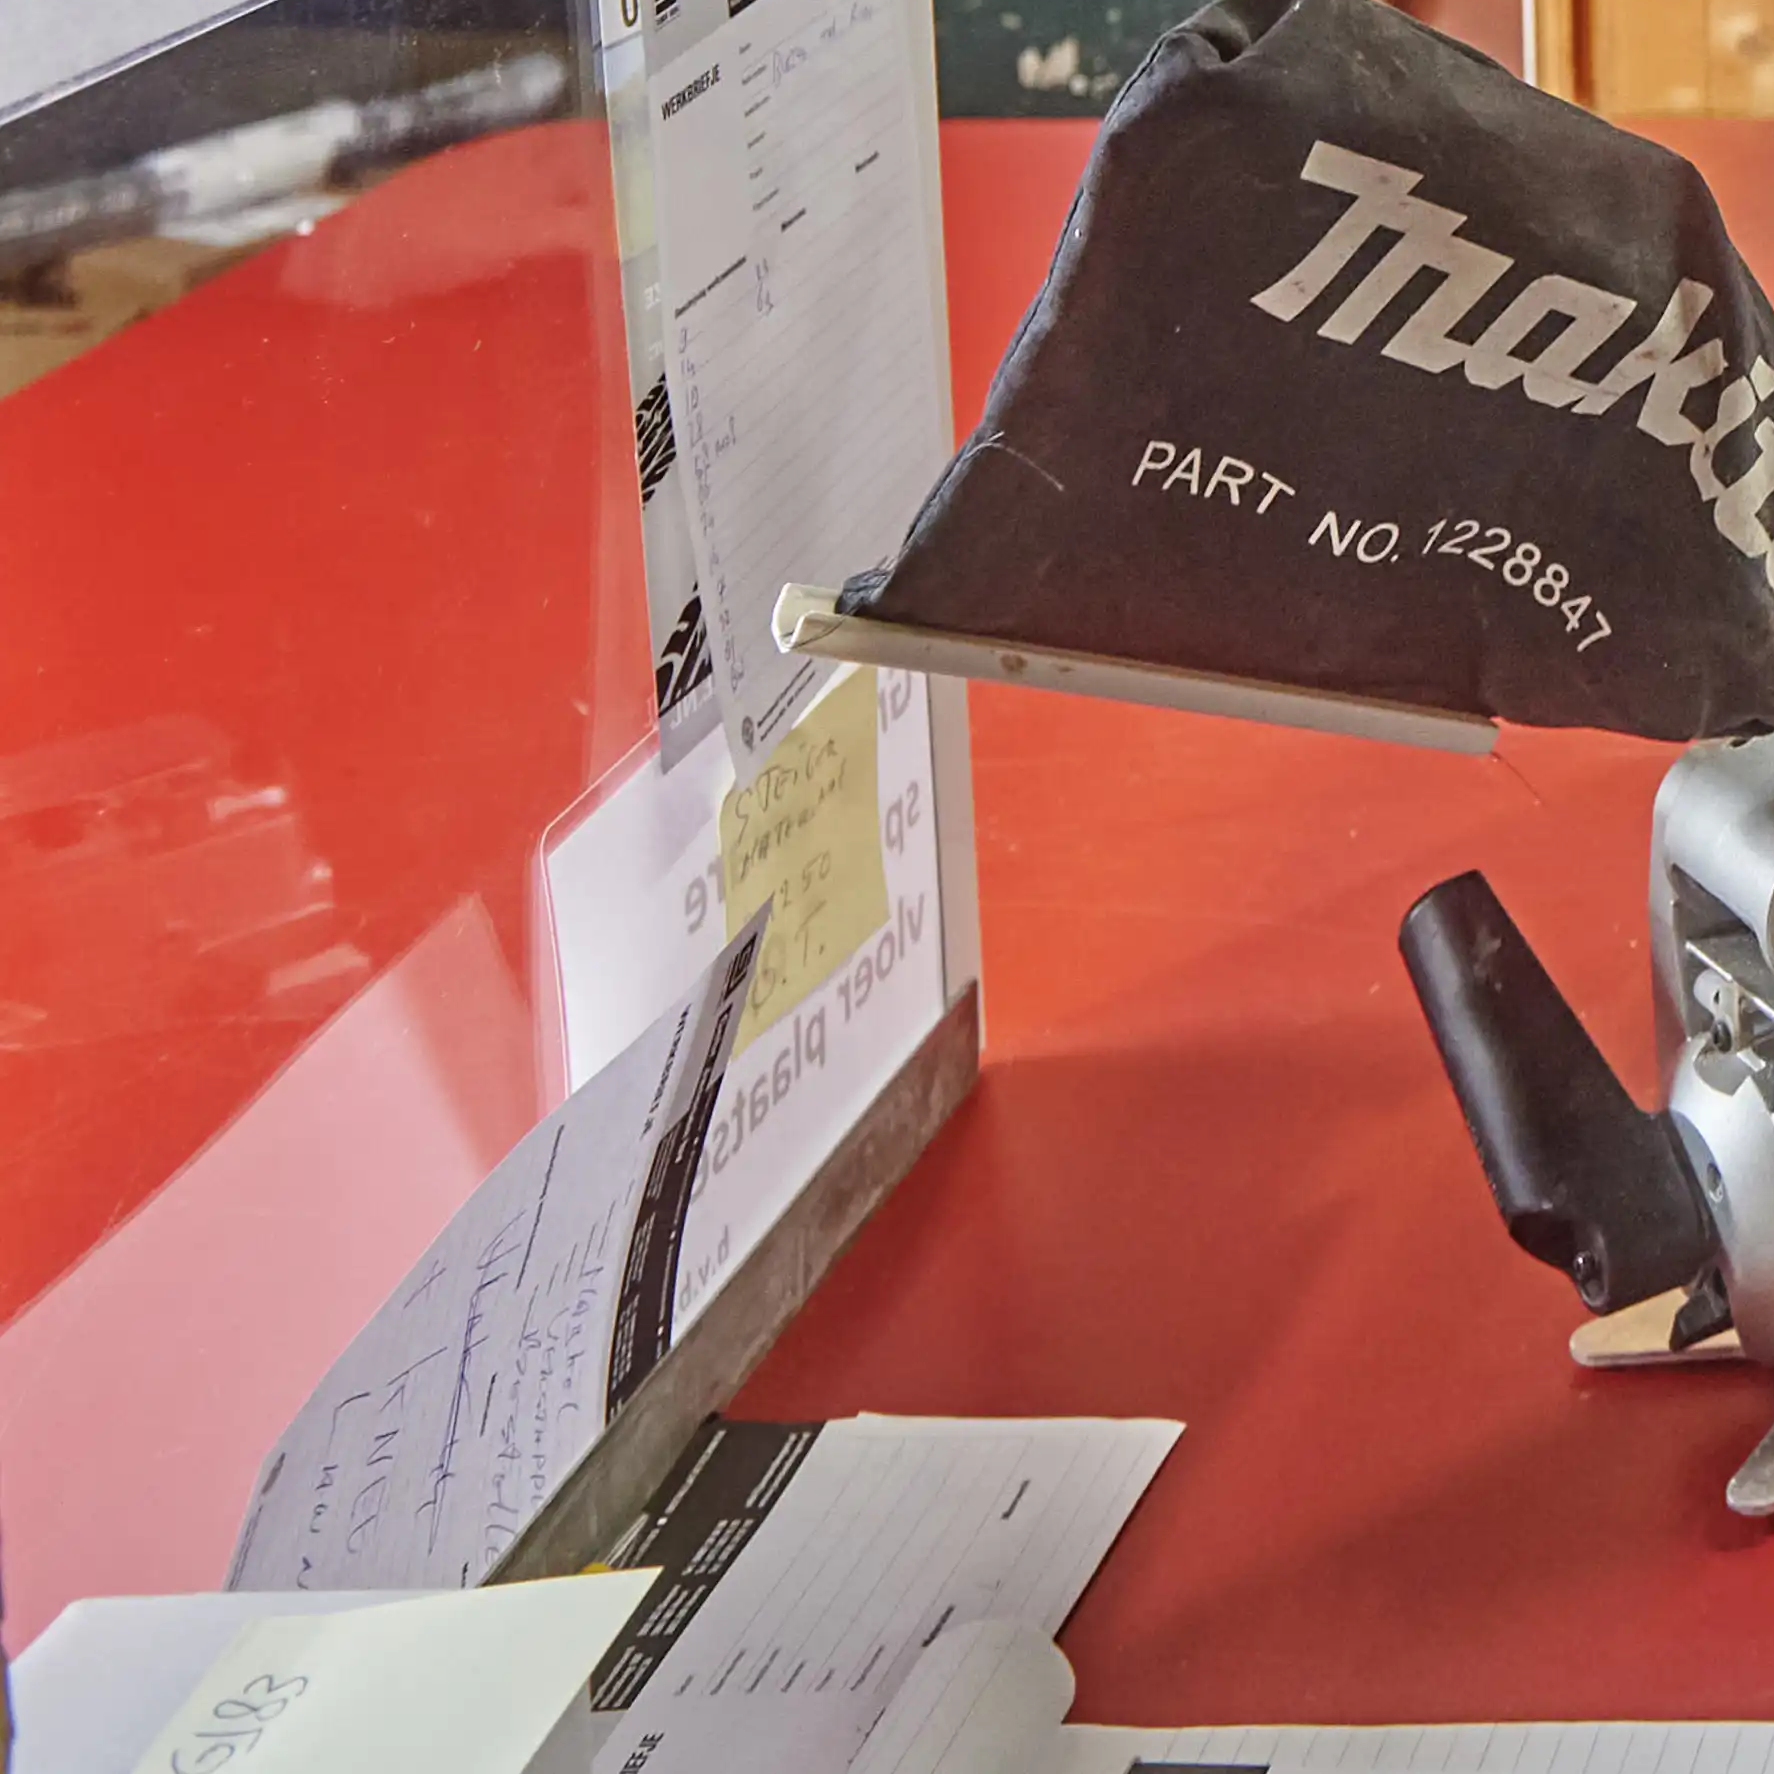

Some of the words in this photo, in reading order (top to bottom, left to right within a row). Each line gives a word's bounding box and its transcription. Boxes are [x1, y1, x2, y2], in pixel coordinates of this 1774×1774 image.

[660, 63, 721, 121] WERKBRIEFJE
[1132, 438, 1296, 517] PART
[1308, 508, 1401, 566] NO.
[1420, 517, 1613, 654] 1228847
